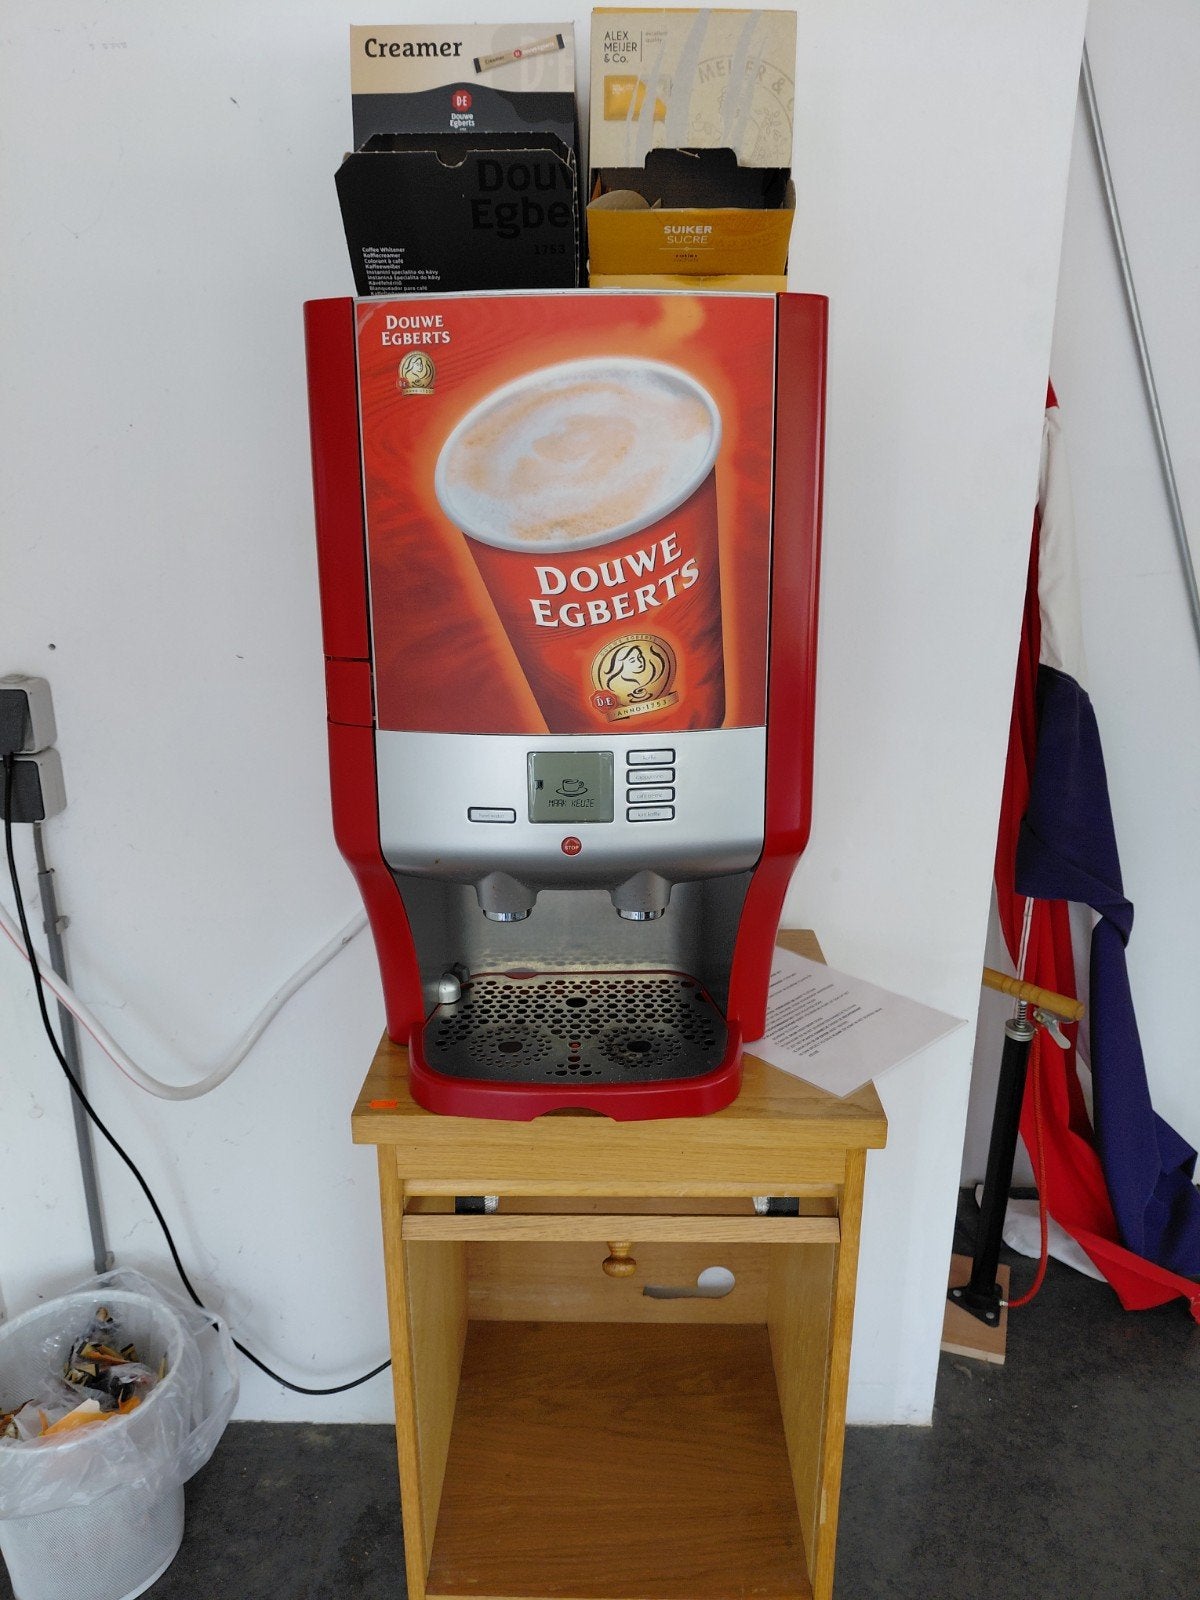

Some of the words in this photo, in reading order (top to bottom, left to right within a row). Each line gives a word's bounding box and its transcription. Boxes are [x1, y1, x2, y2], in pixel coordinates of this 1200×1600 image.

[604, 30, 629, 41] ALEX
[364, 38, 463, 58] Creamer
[603, 42, 638, 52] MEIJER
[604, 53, 611, 63] &
[612, 53, 629, 63] Co.
[698, 60, 768, 84] MEIER
[450, 119, 475, 129] Egberts
[663, 225, 712, 234] SUIKER
[667, 235, 708, 244] SUCRE
[386, 315, 444, 330] DOUWE
[381, 331, 451, 346] EGBERTS
[534, 532, 682, 596] DOUWE
[529, 558, 699, 628] EGBERTS
